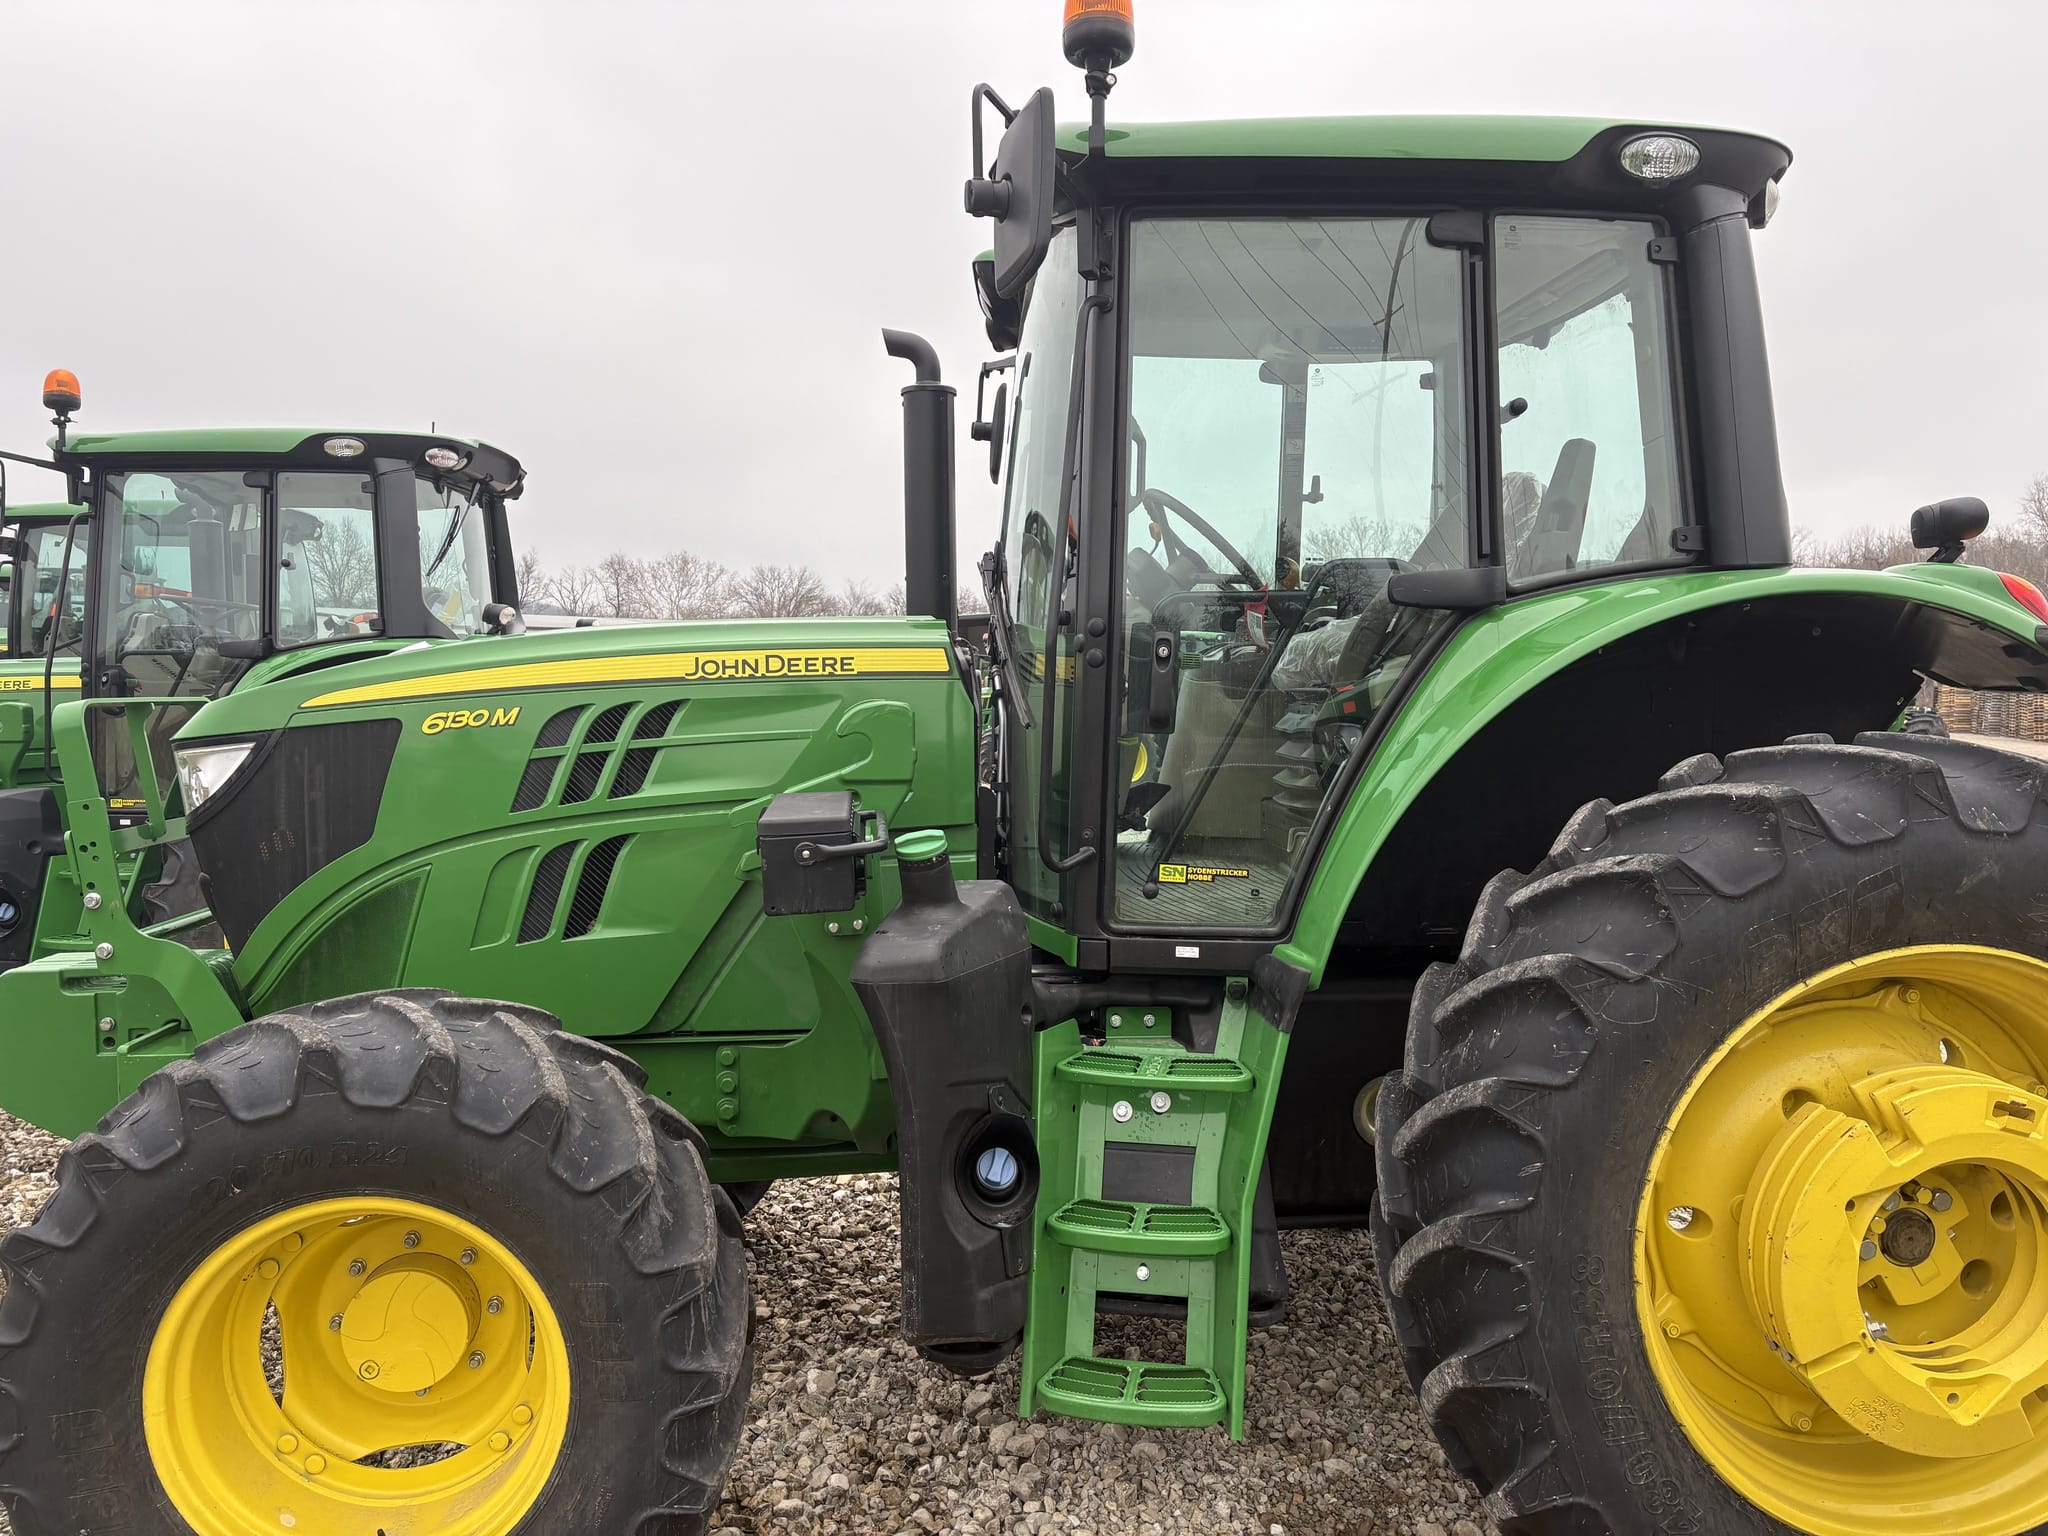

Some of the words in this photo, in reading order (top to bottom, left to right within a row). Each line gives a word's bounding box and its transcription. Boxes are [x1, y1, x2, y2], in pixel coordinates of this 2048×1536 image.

[684, 656, 760, 677] JOHN
[764, 654, 856, 674] DEERE
[1161, 866, 1185, 877] SN
[1187, 867, 1248, 877] SYDENSTRICKER
[1187, 873, 1213, 882] NOBBE
